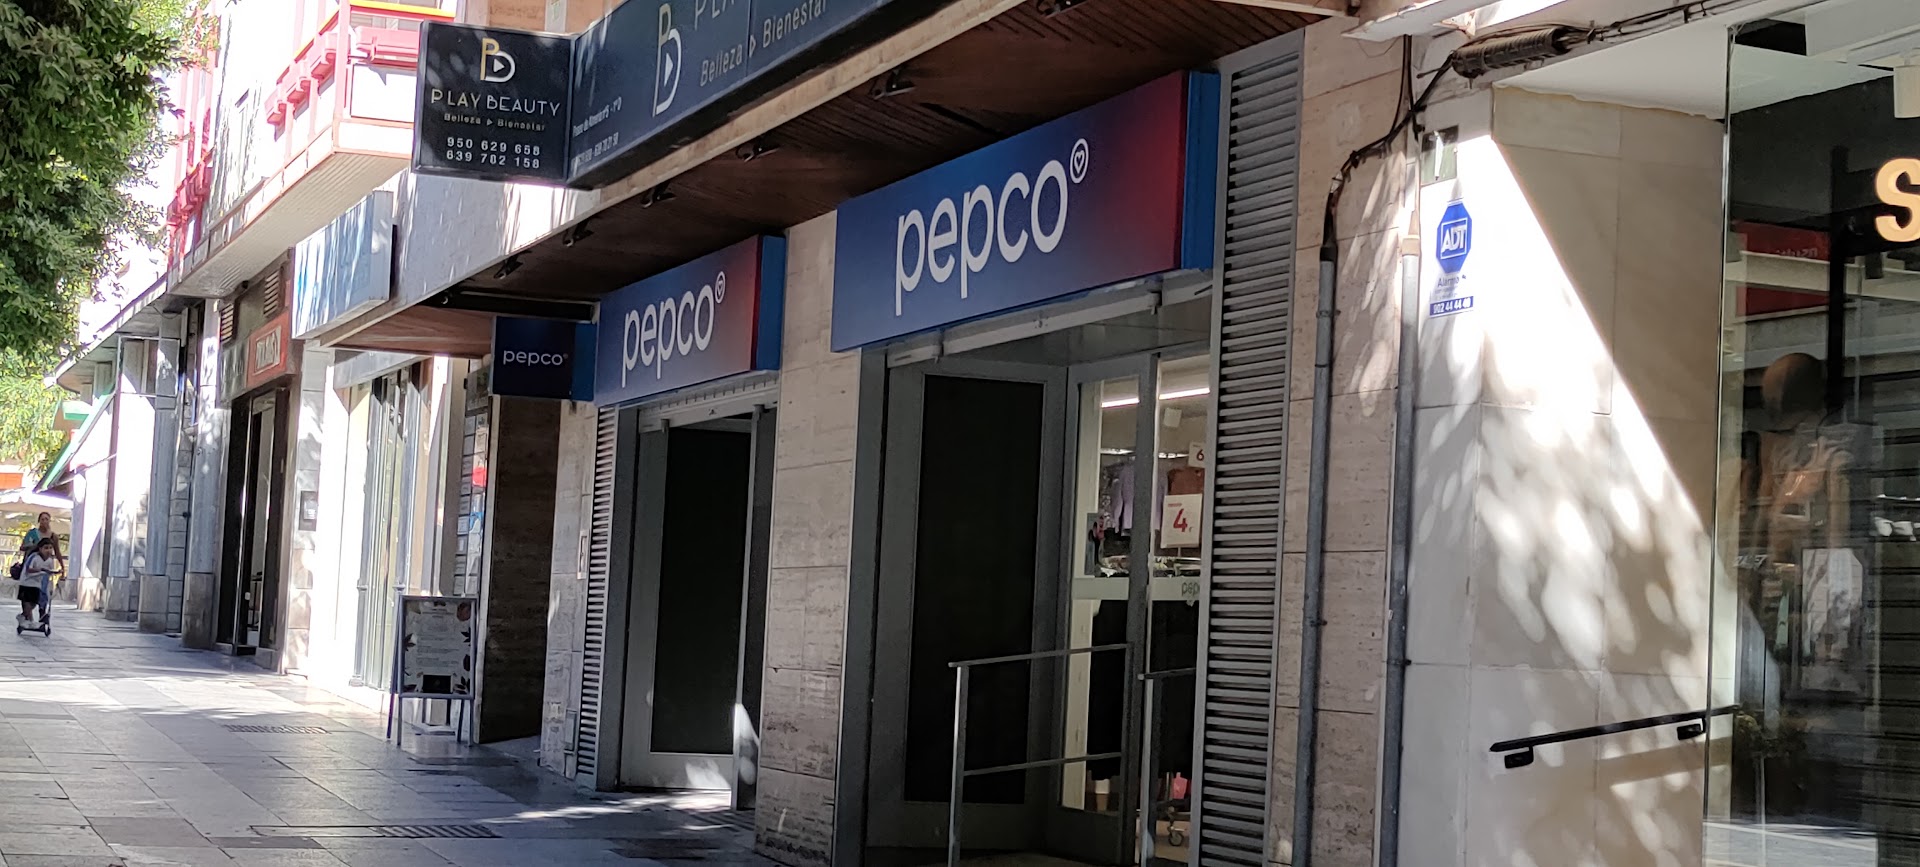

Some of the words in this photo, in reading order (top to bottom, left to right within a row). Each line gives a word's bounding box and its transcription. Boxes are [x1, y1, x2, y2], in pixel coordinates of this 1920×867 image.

[700, 44, 743, 87] Belleza
[431, 88, 481, 108] PLAY
[486, 94, 560, 116] BEAUTY
[444, 113, 481, 125] Belleza
[497, 118, 545, 132] Bienestar
[447, 136, 473, 149] 950
[481, 140, 507, 153] 629
[514, 144, 540, 156] 658
[446, 149, 473, 162] 639
[480, 153, 506, 166] 702
[514, 156, 540, 169] 158
[895, 160, 1068, 316] pepco
[1441, 226, 1467, 252] ADT
[621, 285, 715, 388] pepco
[503, 350, 563, 366] pepco
[1173, 508, 1188, 532] 4
[1181, 581, 1200, 597] pep
